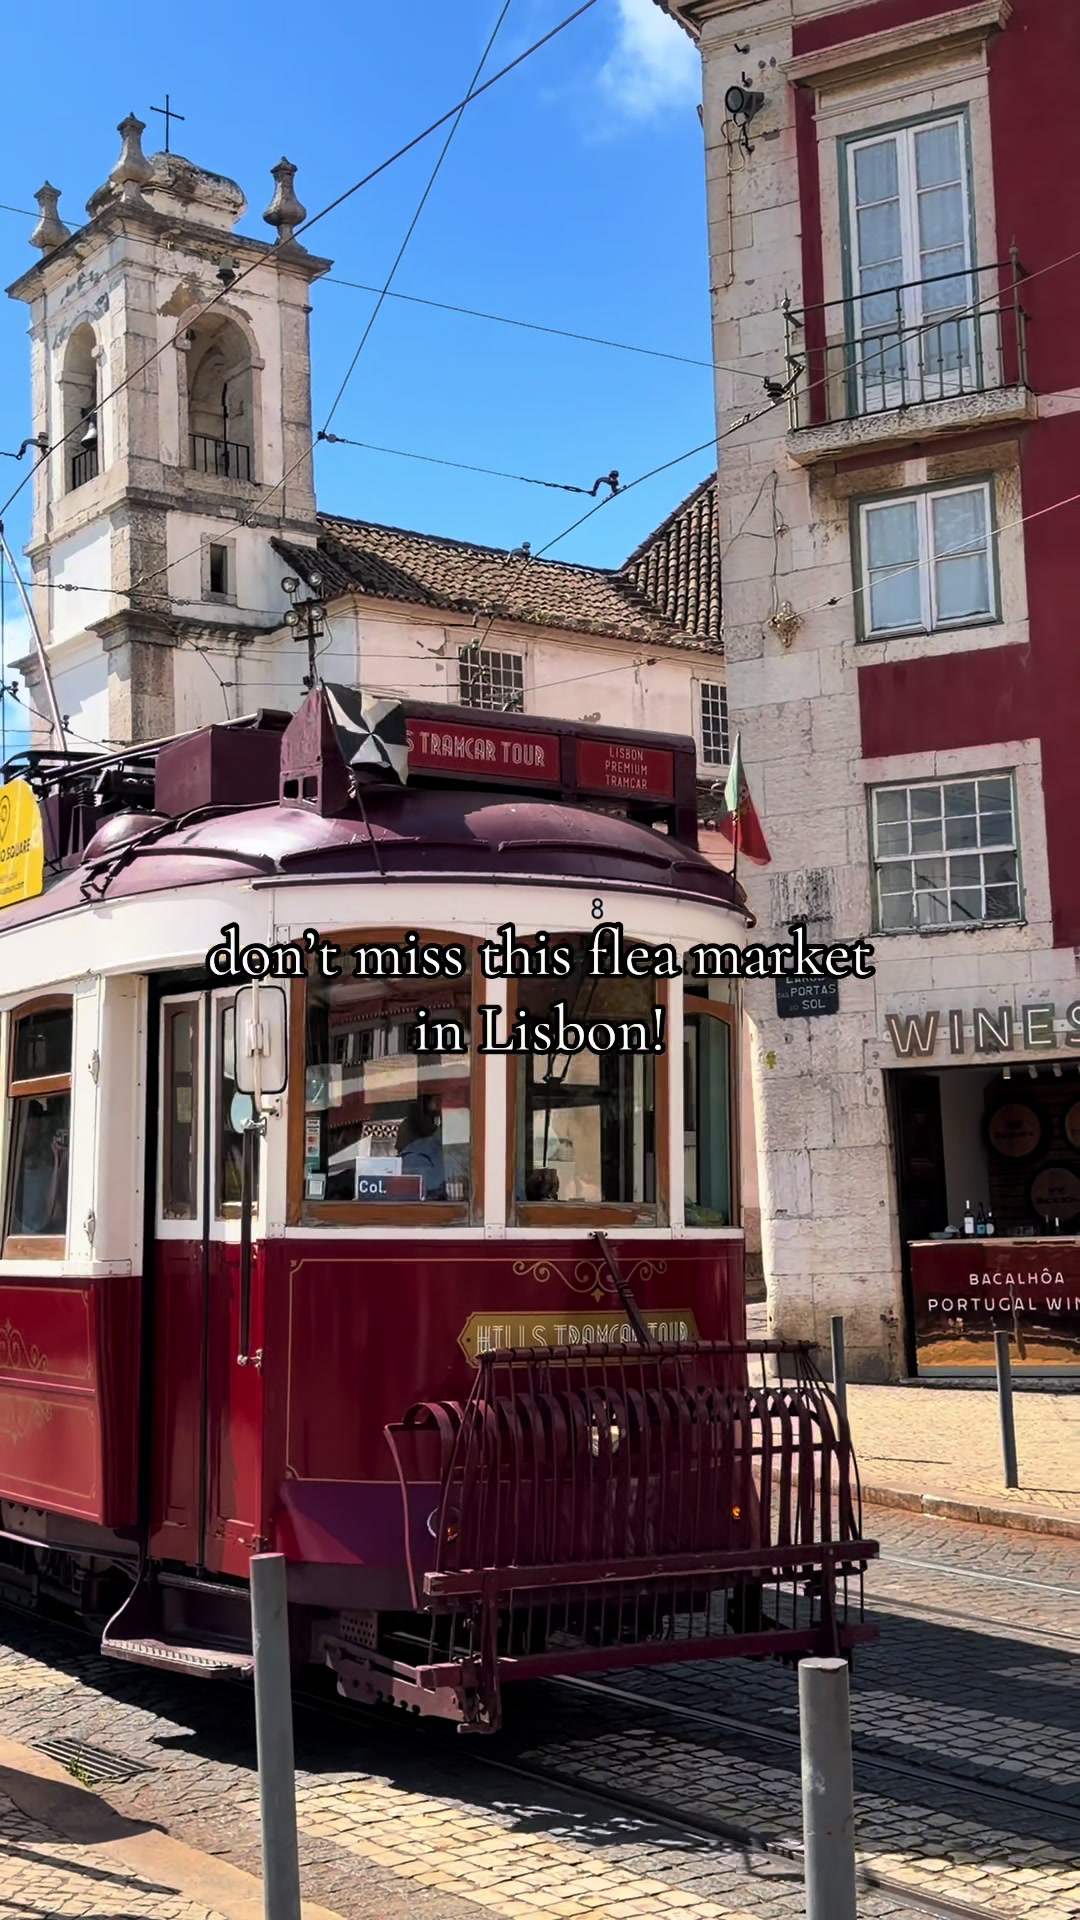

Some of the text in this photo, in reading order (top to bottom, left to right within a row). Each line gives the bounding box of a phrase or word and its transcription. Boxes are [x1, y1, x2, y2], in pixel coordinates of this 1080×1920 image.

[419, 731, 497, 762] TRAMCAR
[501, 741, 545, 768] TOUR
[609, 746, 644, 761] LISBON
[605, 760, 648, 776] PREMIUM
[605, 774, 648, 790] TRAMCAR
[591, 897, 604, 920] 8
[790, 984, 837, 998] PORTAS
[802, 999, 826, 1010] SOL
[359, 1180, 387, 1194] Col.
[968, 1267, 1065, 1286] BACALHÔA
[928, 1297, 1037, 1313] PORTUGAL
